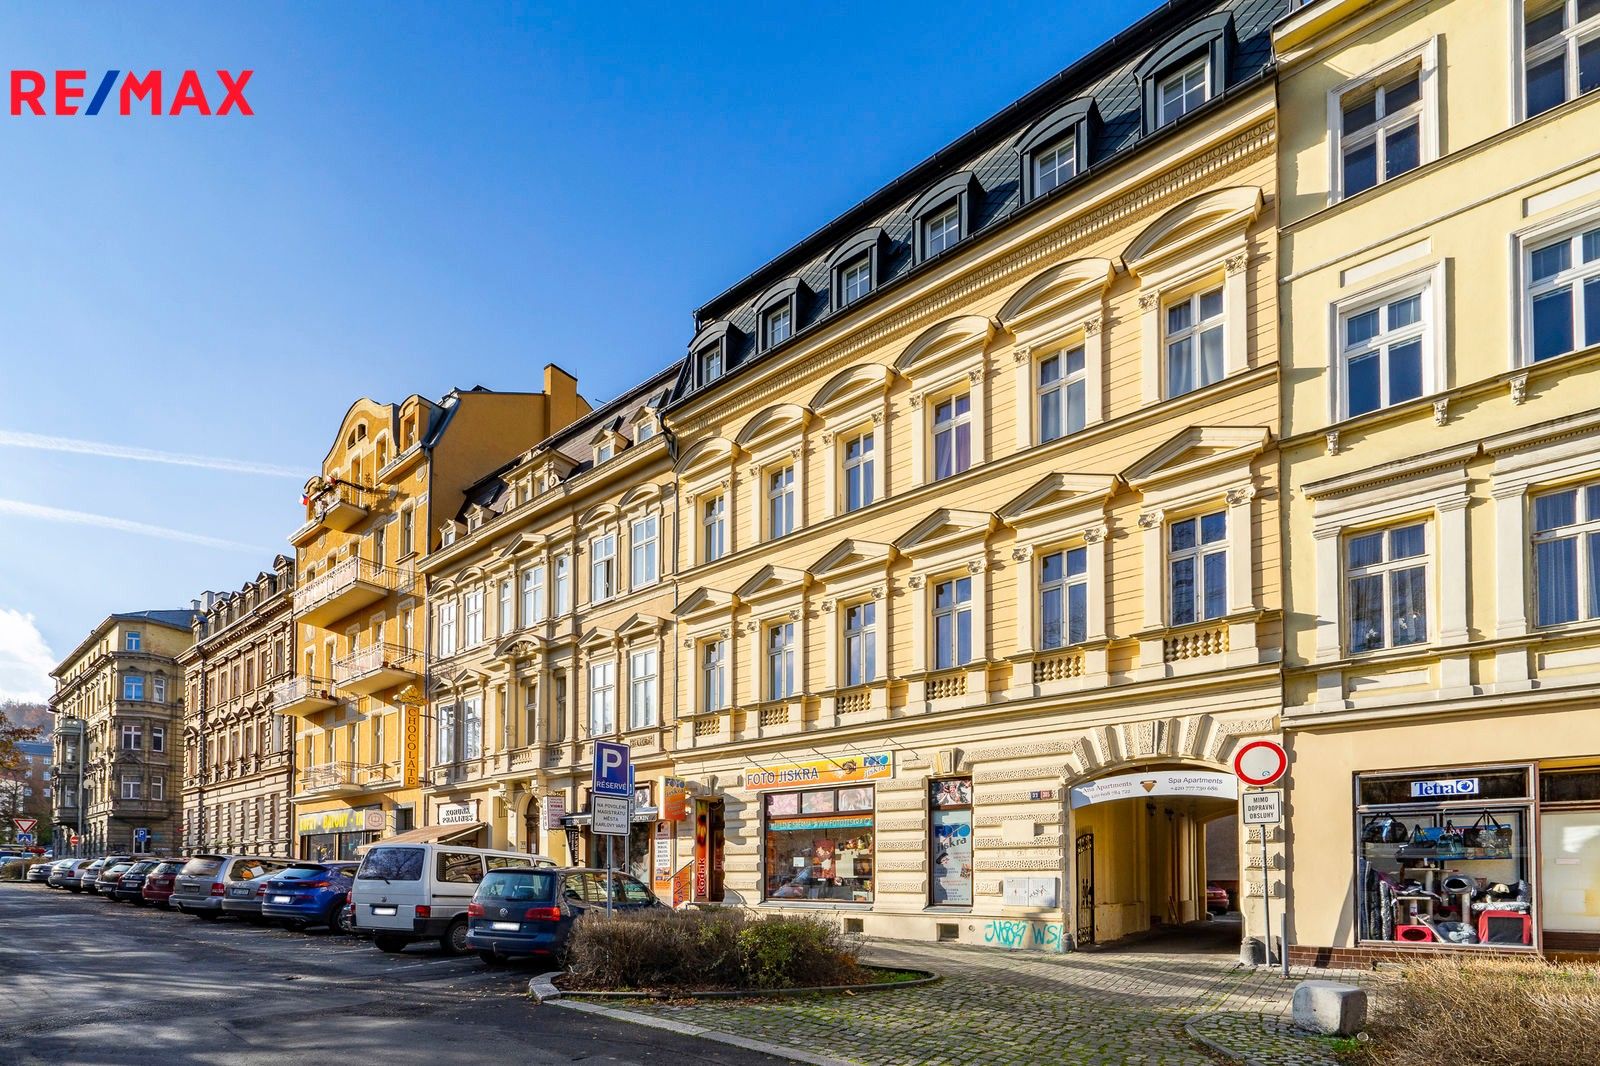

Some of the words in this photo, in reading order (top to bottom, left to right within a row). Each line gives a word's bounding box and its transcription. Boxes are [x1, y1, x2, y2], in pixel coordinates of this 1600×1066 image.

[408, 709, 416, 785] CHOCOLATE
[602, 748, 622, 778] P
[747, 772, 775, 785] FOTO
[778, 768, 819, 783] JISKRA
[1097, 781, 1132, 790] Apartments
[1414, 782, 1455, 795] Tetra
[934, 824, 971, 838] FOTO
[937, 837, 967, 854] jiskra
[697, 858, 705, 896] Kodak
